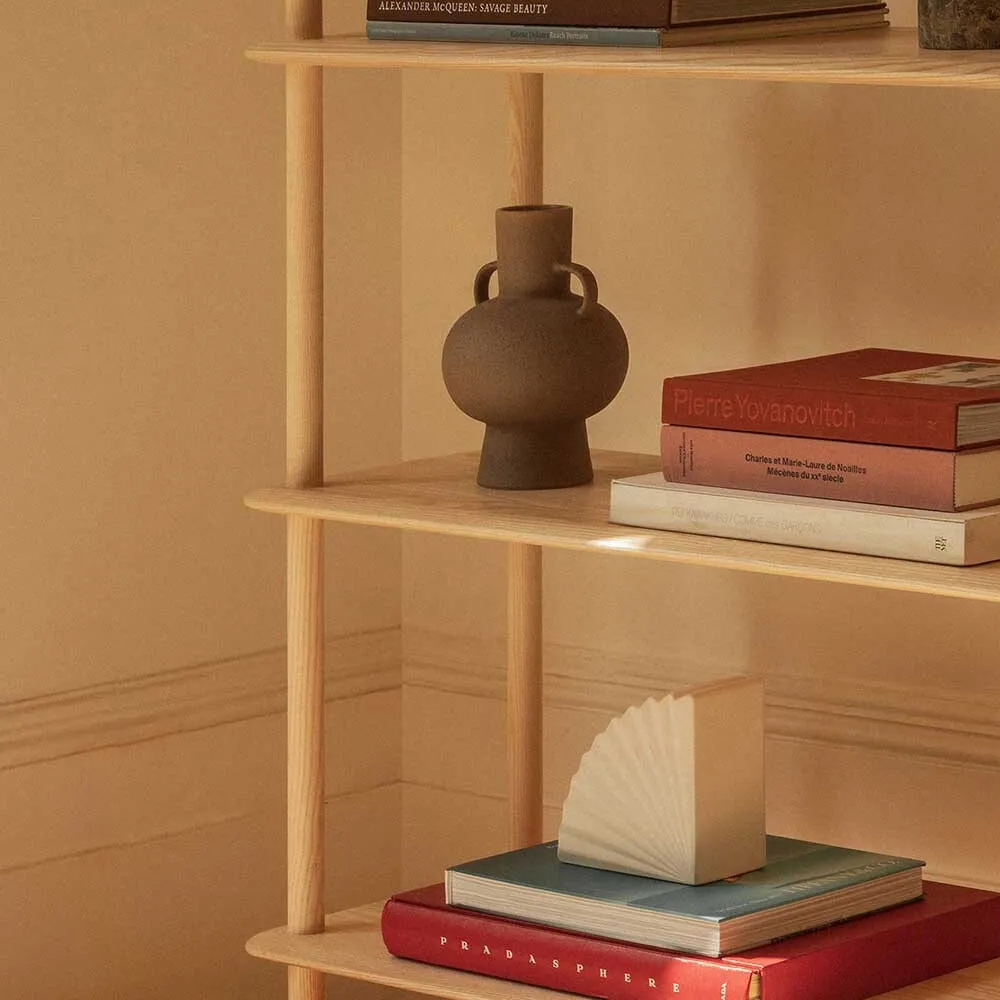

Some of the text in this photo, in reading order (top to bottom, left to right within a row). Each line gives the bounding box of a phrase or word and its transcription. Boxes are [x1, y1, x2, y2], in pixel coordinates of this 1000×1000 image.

[379, 1, 430, 11] ALEXANDER
[480, 3, 511, 13] SAVAGE
[514, 4, 548, 14] BEAUTY
[673, 388, 732, 418] Pierre
[735, 394, 856, 428] Yovanovitch
[745, 453, 772, 464] Charles
[783, 458, 825, 470] Marie-Laure
[827, 462, 836, 470] de
[838, 463, 867, 475] Noailles
[801, 470, 810, 479] du
[440, 936, 680, 992] PRADASPHERE
